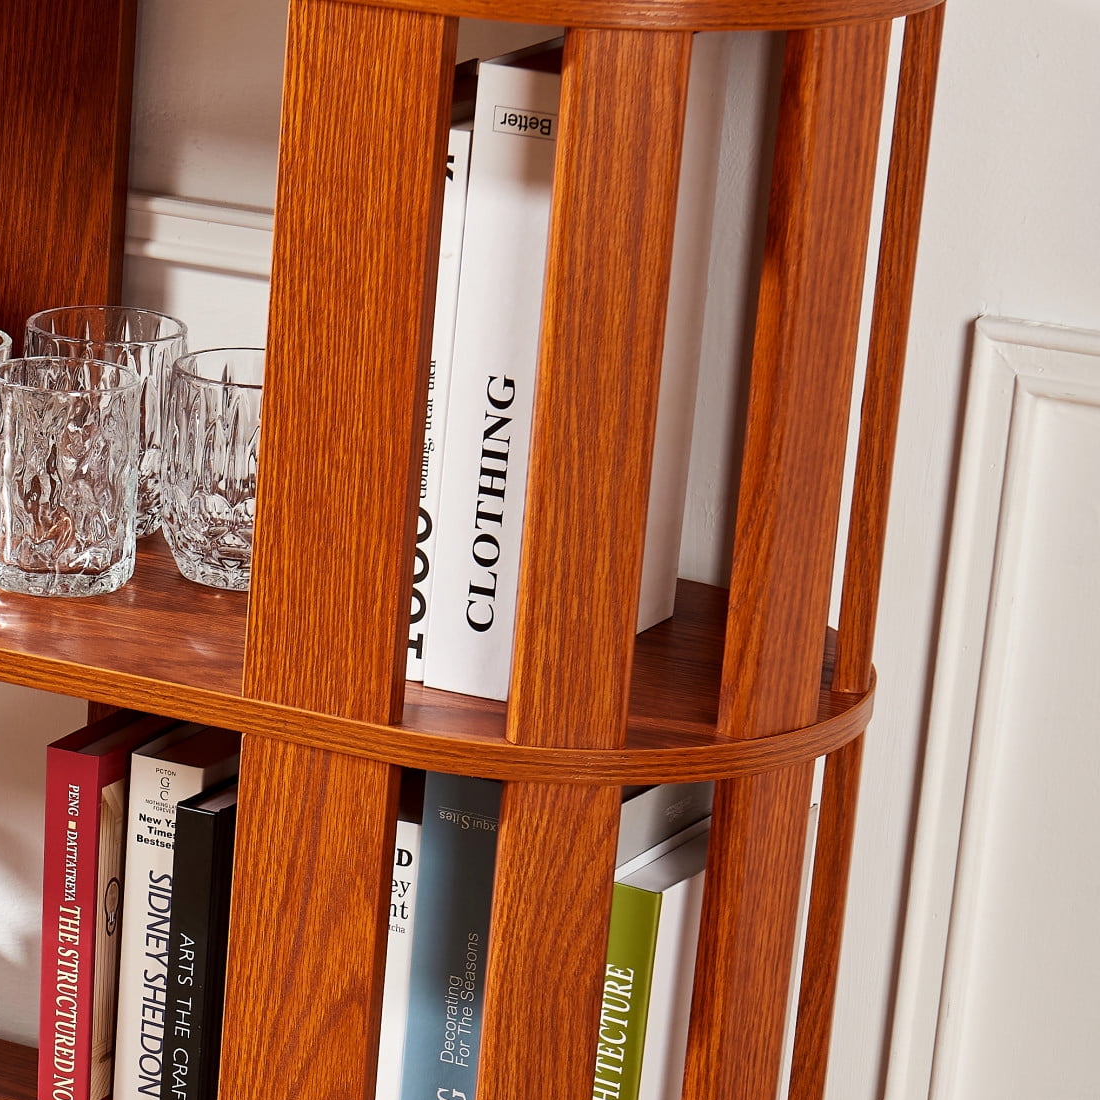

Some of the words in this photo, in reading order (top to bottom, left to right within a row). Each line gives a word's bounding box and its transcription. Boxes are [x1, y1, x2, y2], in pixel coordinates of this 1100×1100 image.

[500, 113, 552, 135] Better
[466, 374, 516, 633] CLOTHING
[68, 784, 80, 816] PENG
[139, 813, 162, 825] New
[58, 905, 81, 946] THE
[145, 870, 172, 968] SIDNEY
[178, 932, 195, 987] ARTS
[460, 933, 479, 1002] Seasons
[52, 947, 79, 1073] STRUCTURED
[138, 969, 167, 1098] SHELDON
[174, 998, 192, 1039] THE
[440, 975, 463, 1064] Decorating
[457, 1006, 473, 1035] The
[456, 1037, 470, 1067] For
